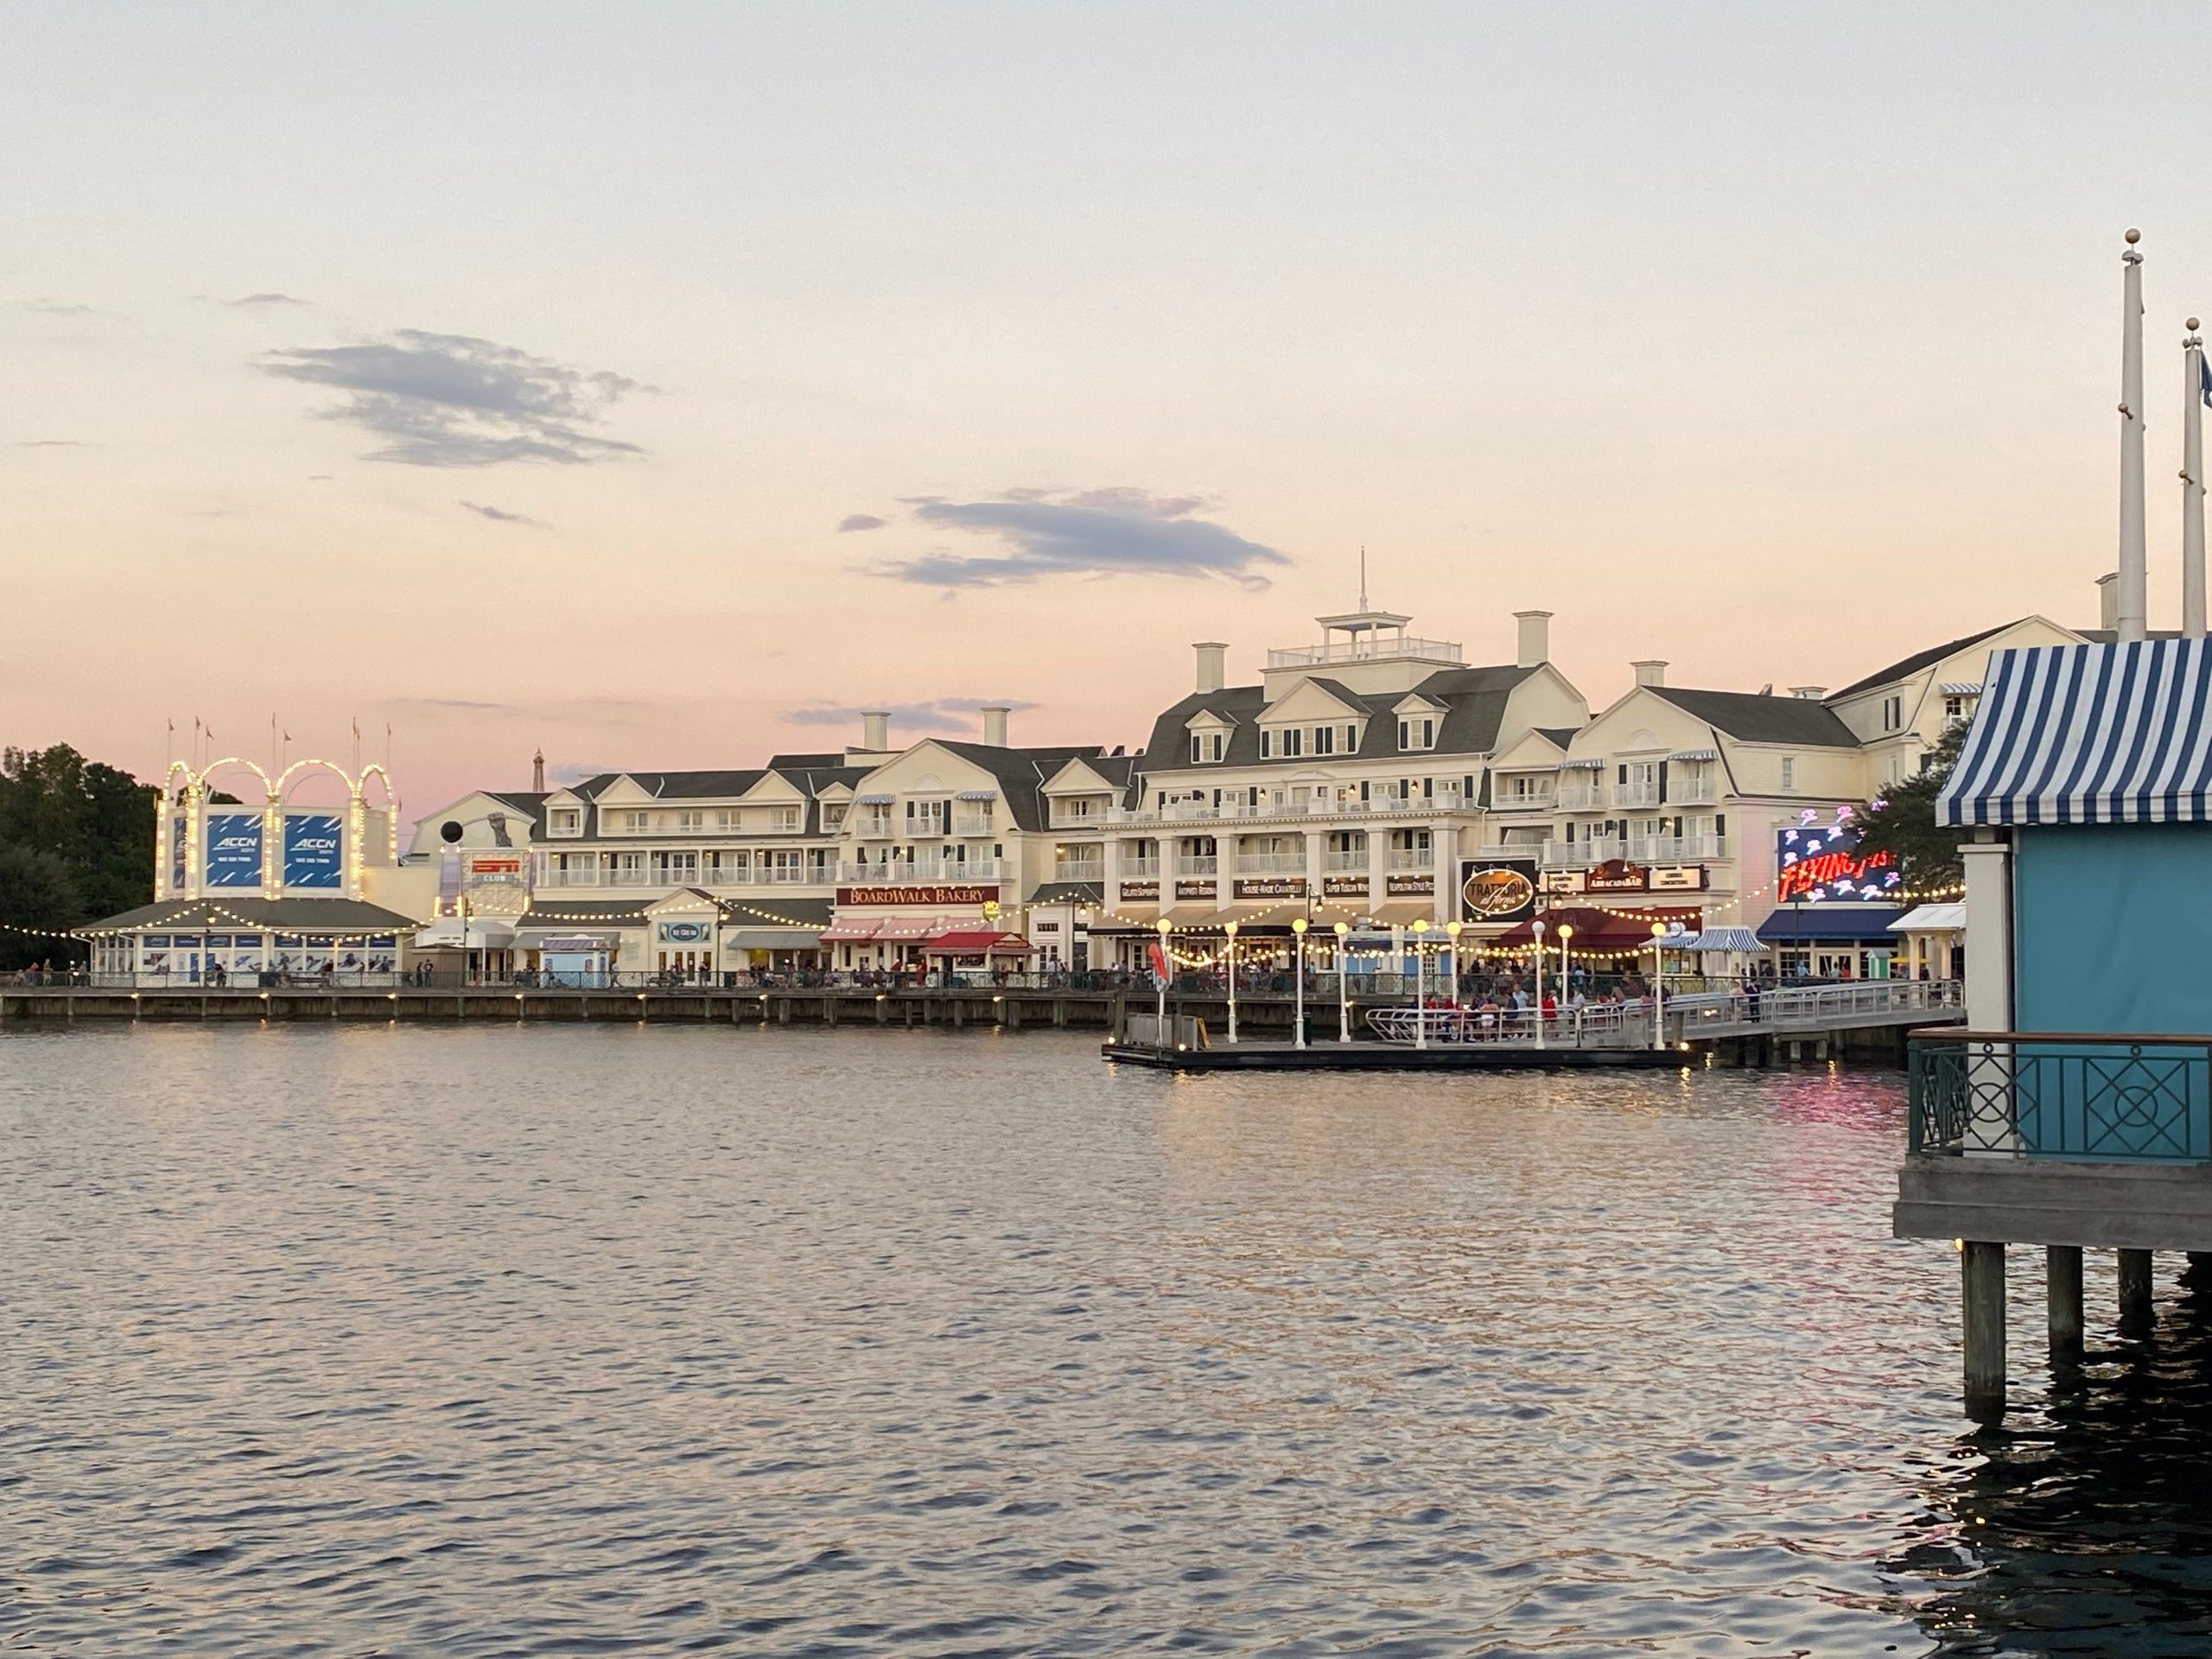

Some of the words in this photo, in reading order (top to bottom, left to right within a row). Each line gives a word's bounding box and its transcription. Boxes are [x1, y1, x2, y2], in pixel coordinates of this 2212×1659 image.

[217, 837, 257, 847] ACCN
[295, 838, 336, 849] ACCN
[472, 861, 520, 873] ESPN
[1778, 852, 1855, 902] FLYING
[1242, 885, 1274, 894] HOUSE-MADE
[1325, 884, 1340, 893] SUPER
[1470, 883, 1527, 896] TRATTORIA
[850, 888, 931, 904] BOARDWALK
[936, 888, 985, 903] BAKERY
